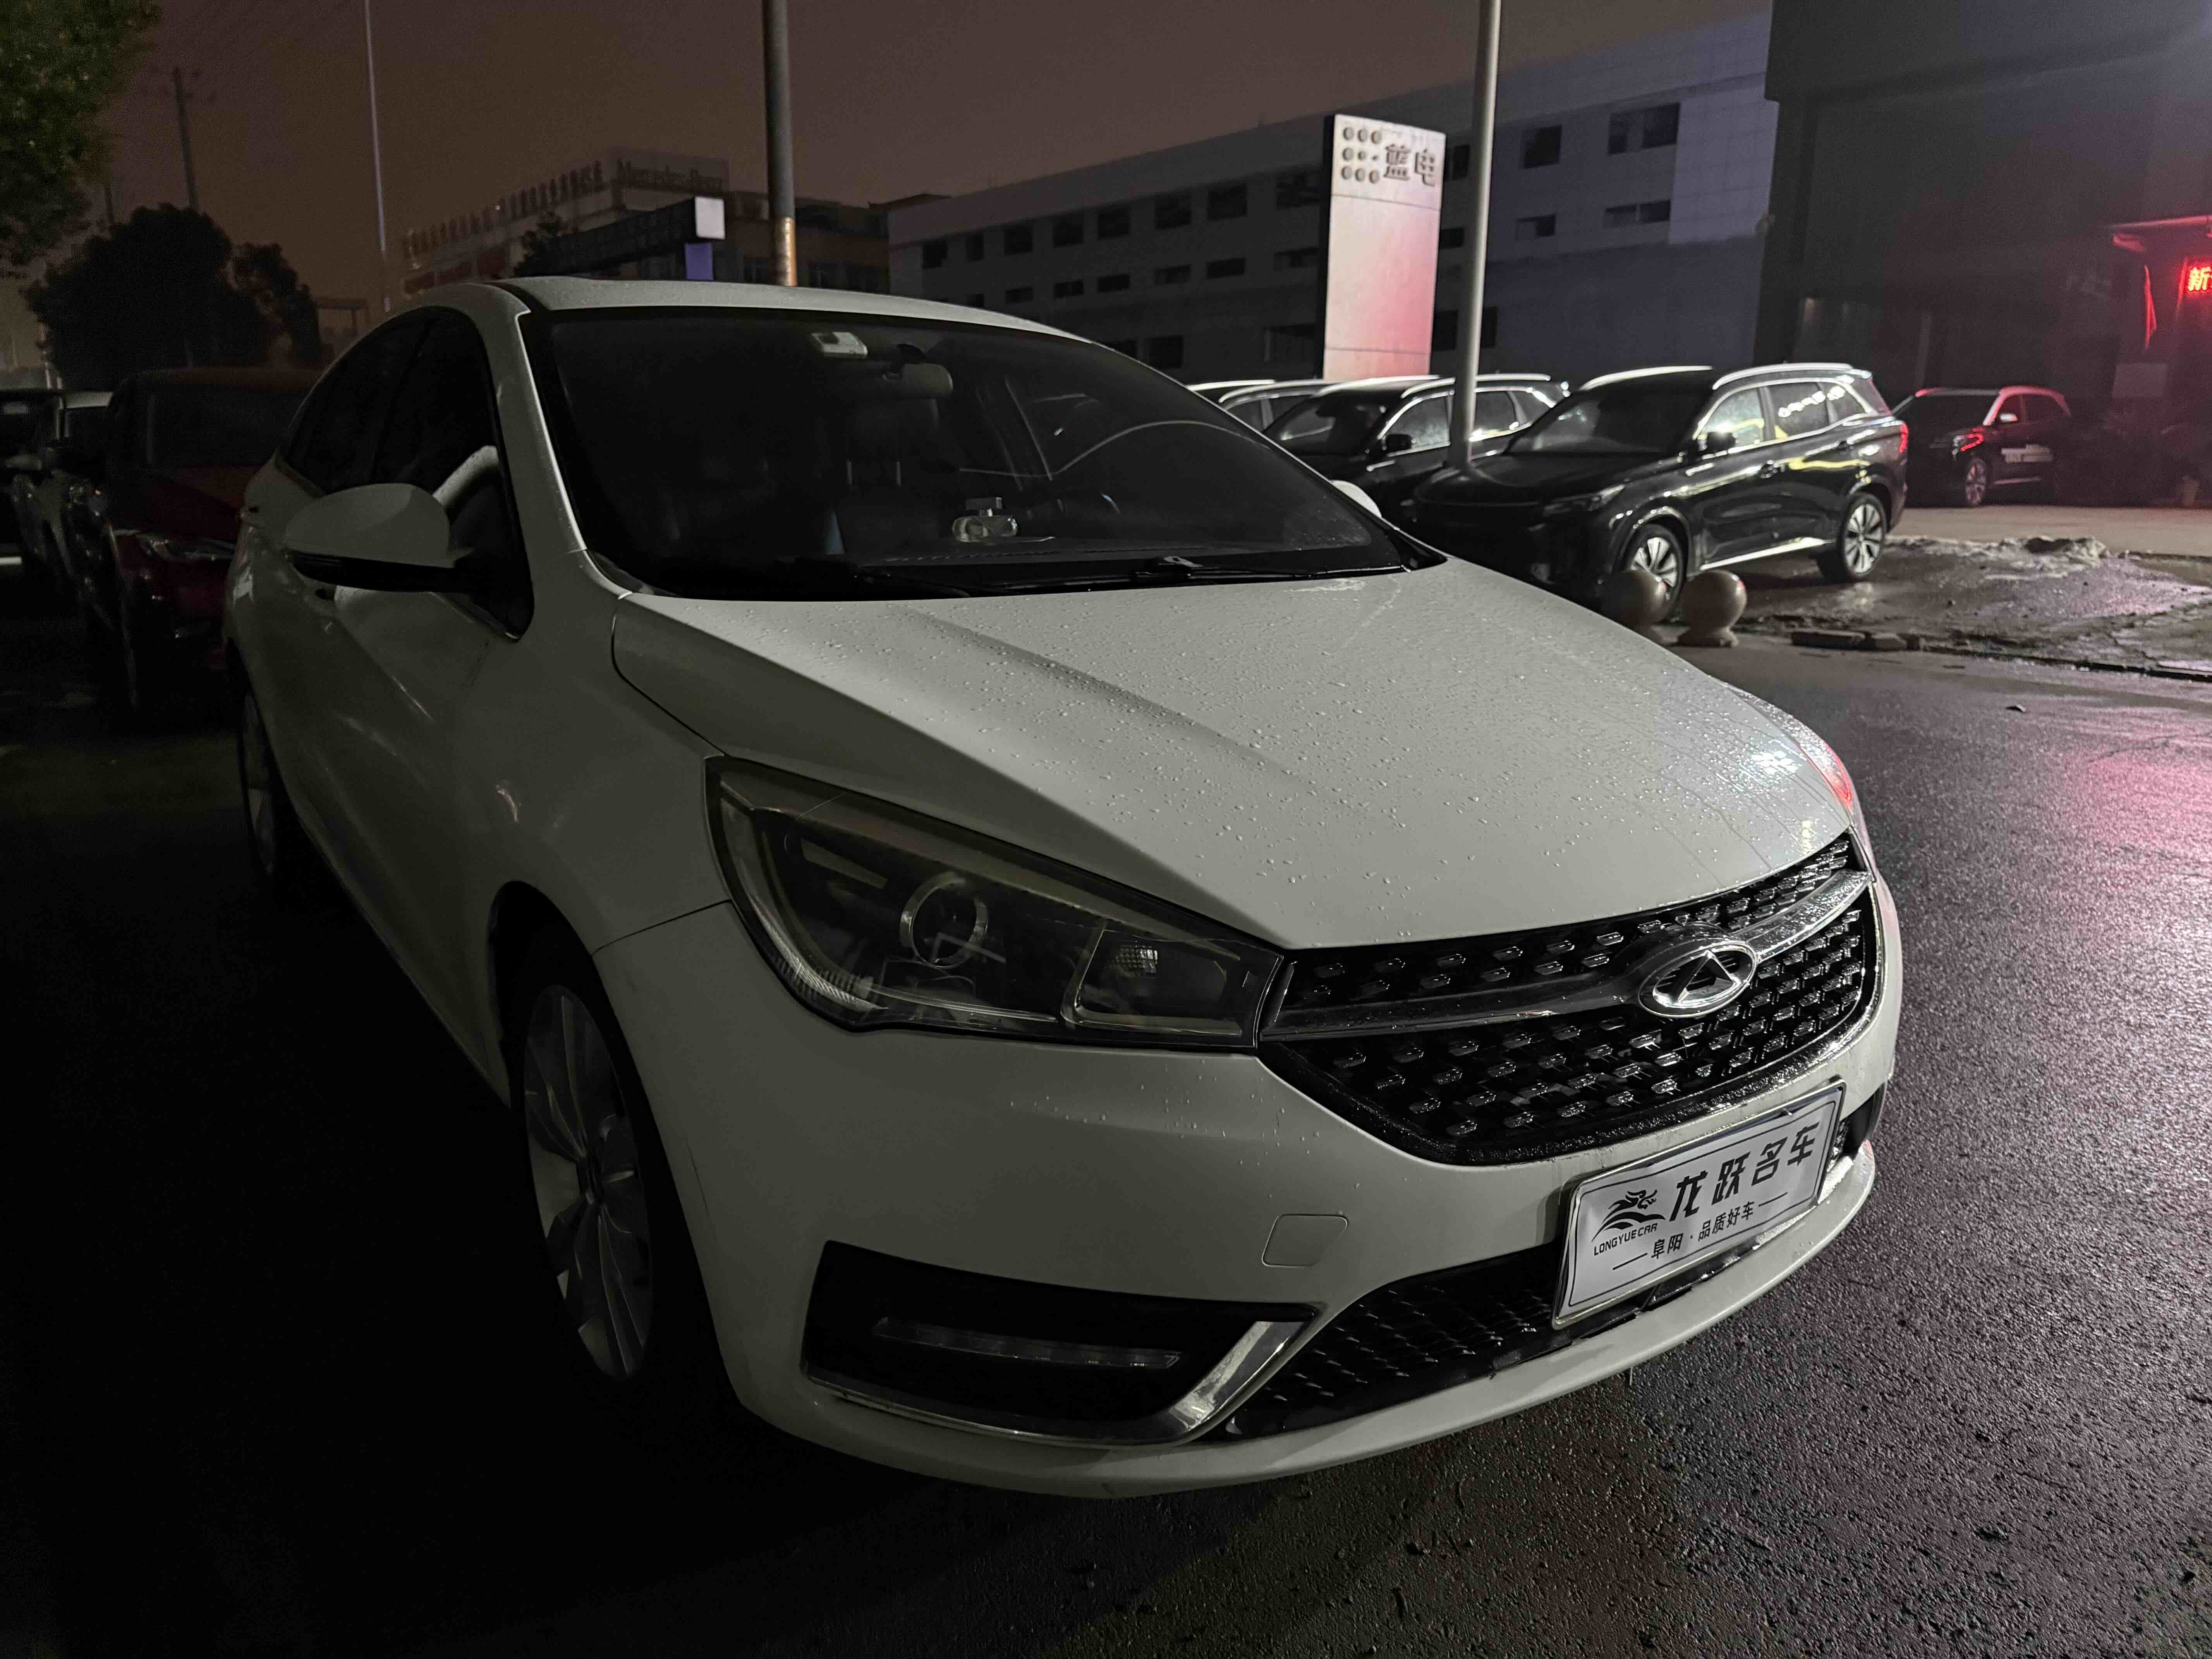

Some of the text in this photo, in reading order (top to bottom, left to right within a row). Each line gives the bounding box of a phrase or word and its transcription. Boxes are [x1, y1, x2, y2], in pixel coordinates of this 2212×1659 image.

[1384, 144, 1436, 187] 蓝电
[2187, 266, 2212, 291] 新
[1669, 1121, 1820, 1222] 龙跃名车
[1594, 1223, 1657, 1256] LONGYUECAR
